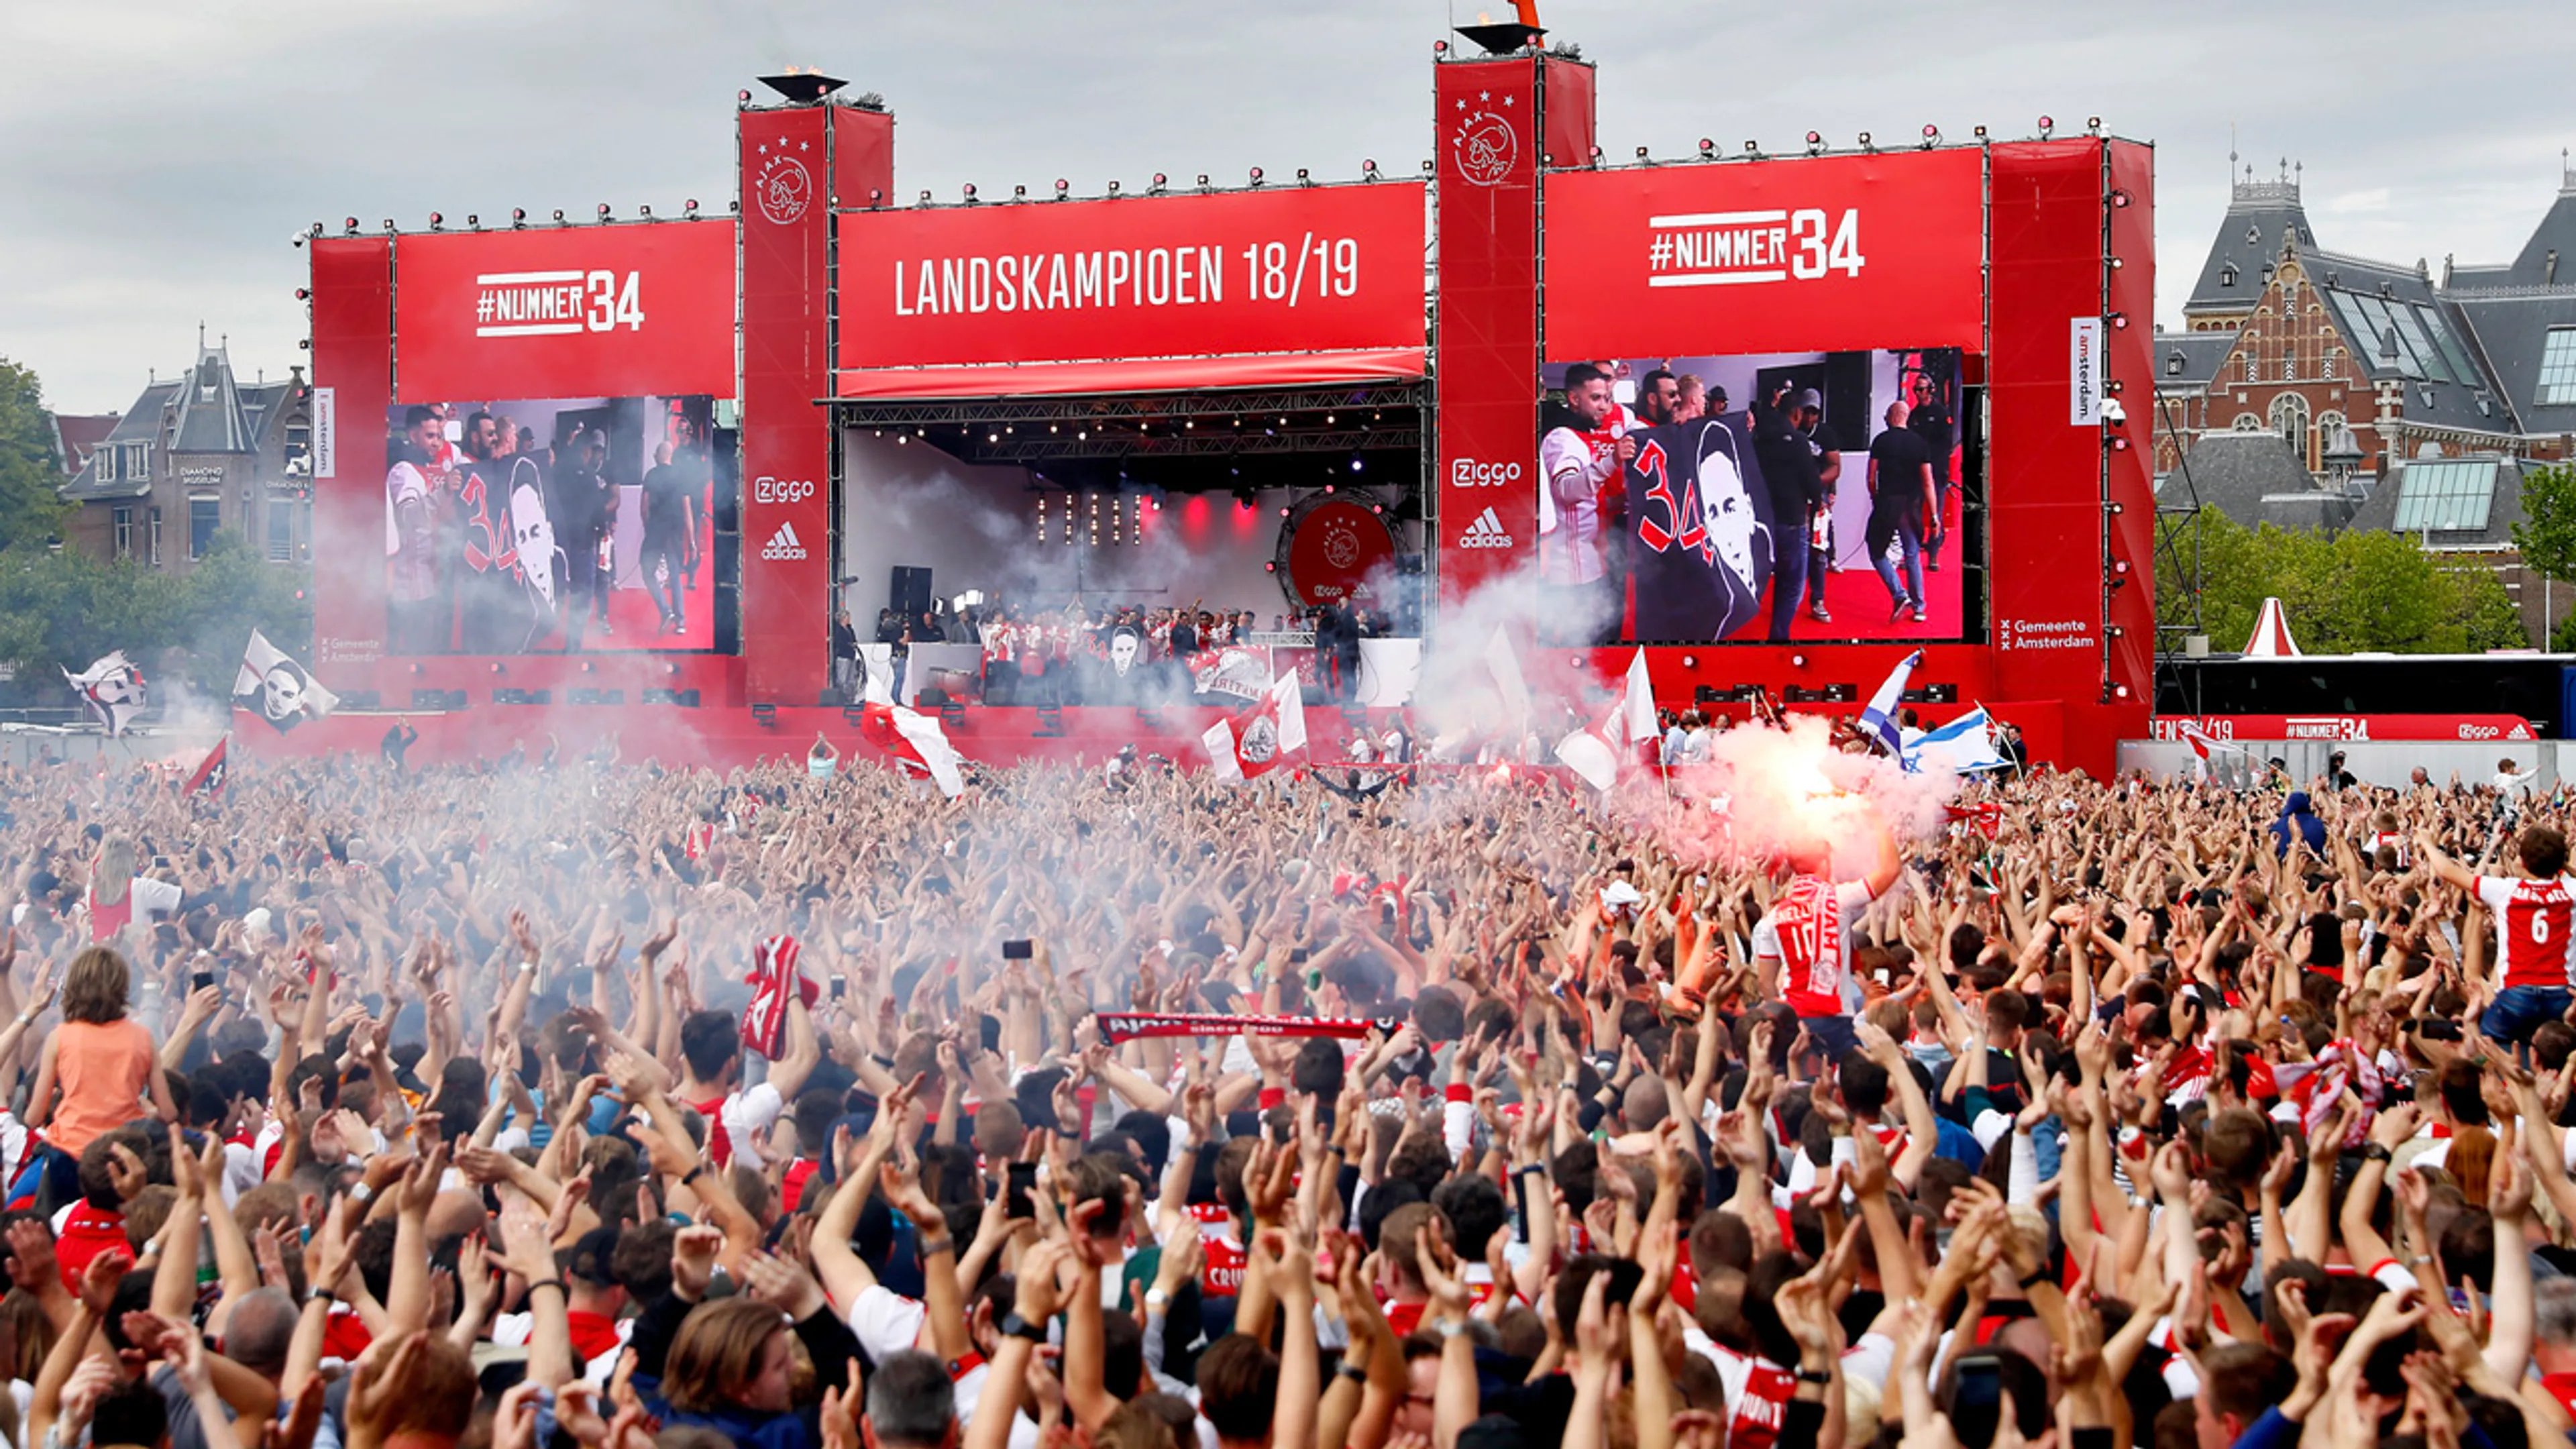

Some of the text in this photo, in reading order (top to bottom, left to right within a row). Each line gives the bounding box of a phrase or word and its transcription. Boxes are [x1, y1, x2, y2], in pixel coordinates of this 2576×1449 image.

[1452, 111, 1483, 148] AJAX
[755, 155, 782, 189] AJAX
[1649, 208, 1866, 280] #NUMMER34
[895, 231, 1358, 316] LANDSKAMPIOEN 18/19
[476, 270, 645, 333] #NUMMER34
[180, 466, 223, 477] DIAMOND
[182, 476, 221, 485] MUSEUM
[1633, 438, 1715, 570] 34
[460, 472, 523, 587] 34
[1458, 533, 1513, 549] adidas
[761, 544, 808, 561] adidas
[2014, 619, 2086, 633] Gemeente
[2014, 634, 2095, 649] Amsterdam
[2531, 908, 2549, 945] 6
[1210, 1266, 1245, 1287] CRU
